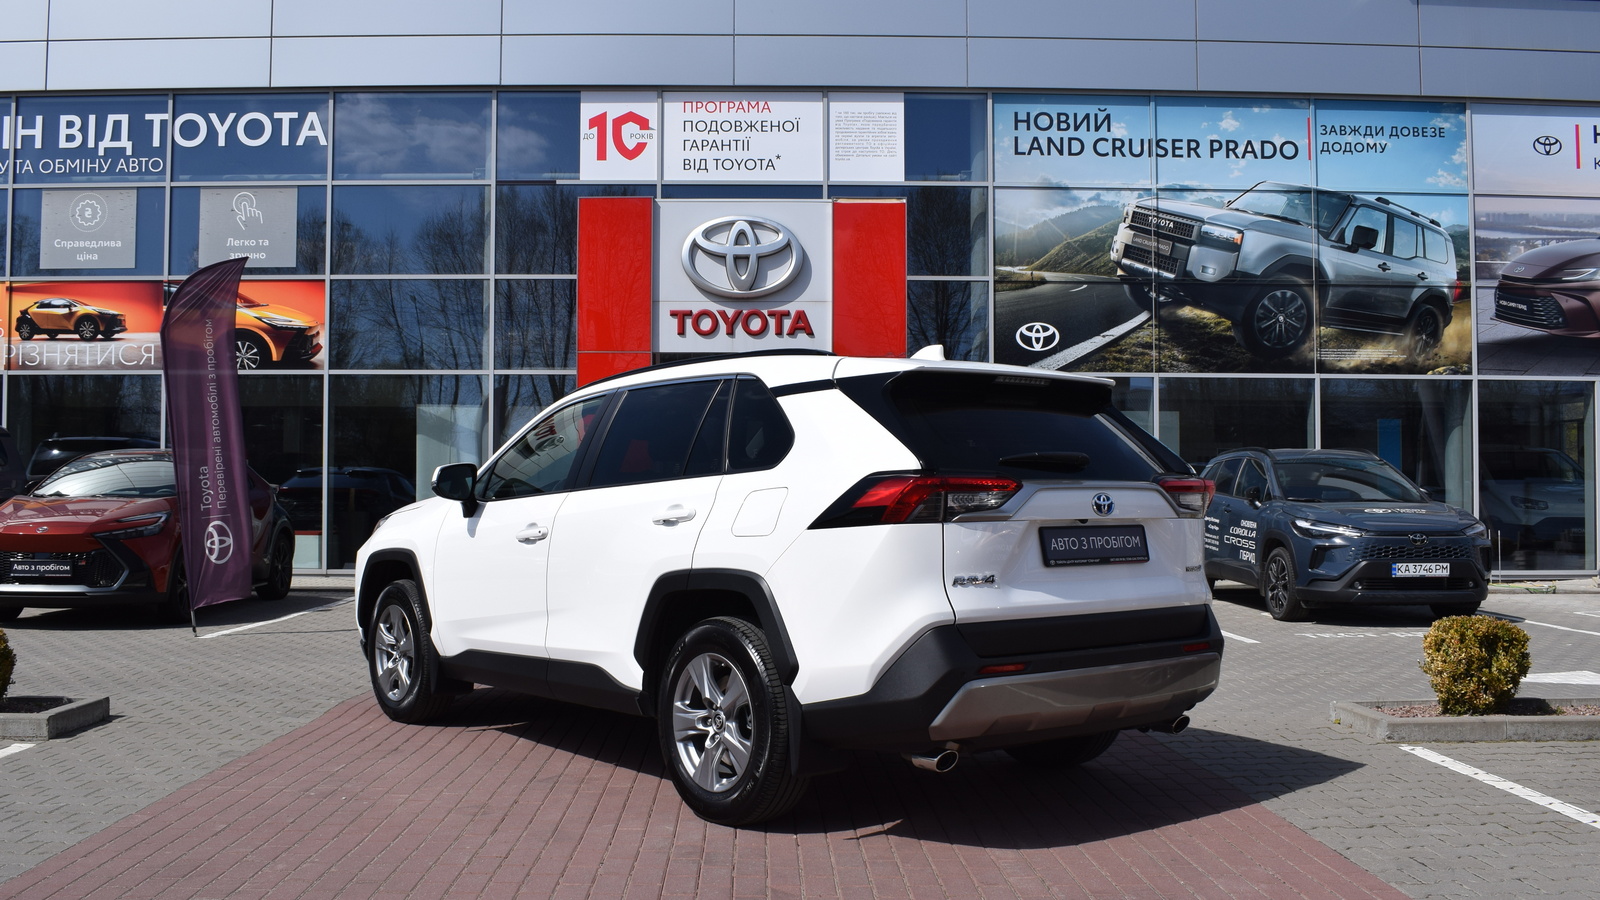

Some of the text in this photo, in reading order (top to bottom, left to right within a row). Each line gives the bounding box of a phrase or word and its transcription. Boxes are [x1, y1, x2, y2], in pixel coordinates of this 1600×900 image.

[683, 101, 772, 113] ПРОГРАМА
[683, 117, 801, 135] ПОДОВЖЕНОЇ
[1013, 108, 1111, 132] НОВИЙ
[59, 114, 132, 155] ВІД
[145, 112, 328, 147] TOYOTA
[582, 132, 595, 140] ДО
[1320, 124, 1446, 139] ЗАВЖДИ ДОВЕЗЕ
[683, 136, 751, 151] ГАРАНТІЇ
[1013, 136, 1299, 160] LAND CRUISER PRADO
[1320, 141, 1388, 155] ДОДОМУ
[15, 160, 34, 174] ТА
[39, 158, 111, 174] ОБМІНУ
[116, 157, 163, 172] АВТО
[683, 158, 709, 173] ВІД
[54, 238, 122, 249] Справедлива
[226, 237, 256, 247] Легко
[76, 251, 99, 261] ціна
[669, 309, 815, 336] TOYOTA
[203, 318, 216, 371] пробігом
[207, 382, 222, 443] автомобілі
[214, 447, 227, 509] Перевірені
[199, 466, 214, 511] Toyota
[1229, 526, 1257, 538] COROLLA
[1051, 535, 1141, 551] АВТО З ПРОБІГОМ
[1223, 535, 1256, 550] CROSS
[13, 563, 30, 571] Авто
[36, 563, 70, 573] пробігом
[1397, 564, 1449, 574] KA 3746 PM
